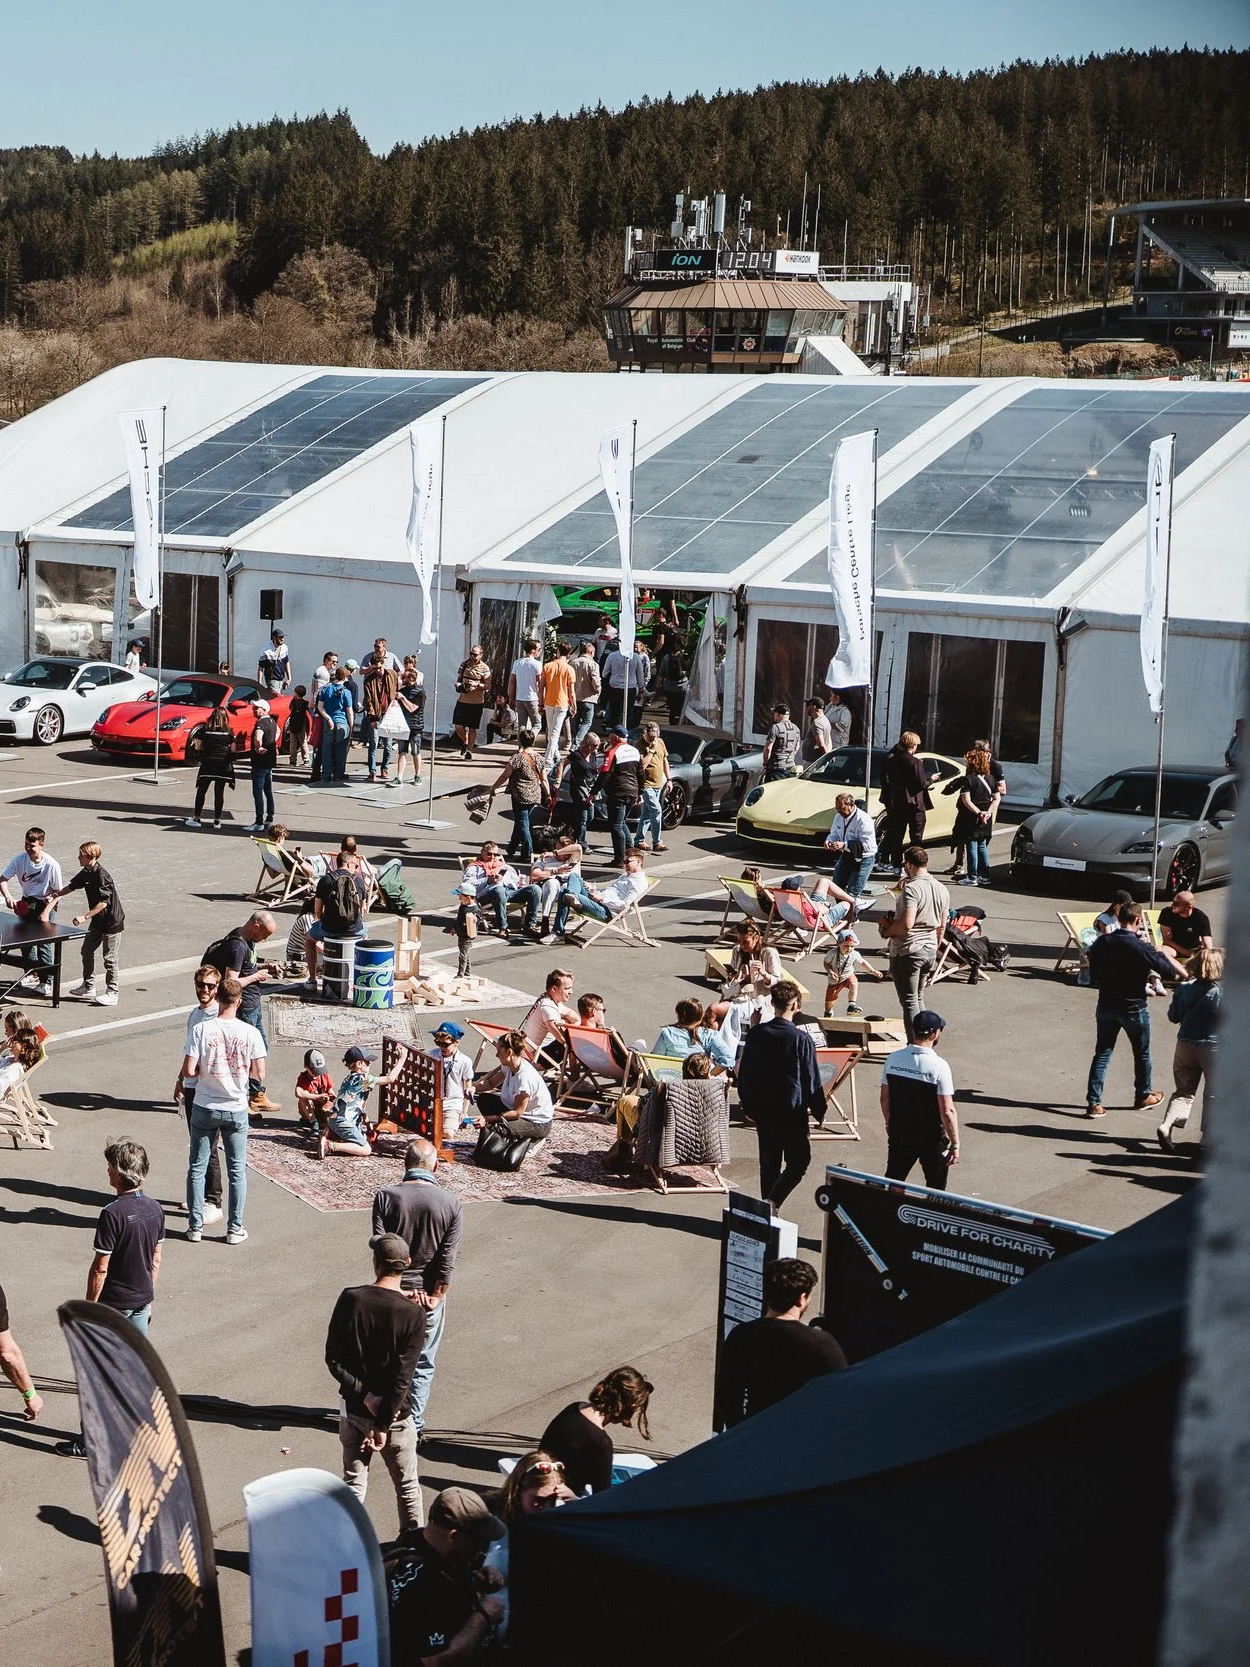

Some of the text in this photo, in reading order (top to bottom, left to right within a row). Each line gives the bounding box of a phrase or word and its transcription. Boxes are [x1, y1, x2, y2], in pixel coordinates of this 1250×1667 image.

[728, 252, 772, 269] 12.04
[647, 337, 658, 345] Royal
[915, 1218, 1056, 1260] DRIVE FOR CHARITY
[912, 1251, 933, 1265] SPORT
[934, 1256, 974, 1275] AUTOMOBILE
[975, 1267, 1001, 1282] CONTRE
[1001, 1273, 1010, 1284] LE
[923, 1242, 958, 1259] MOBILISER
[958, 1251, 967, 1261] LA
[1014, 1264, 1025, 1276] DU
[116, 1542, 143, 1590] CAR
[138, 1449, 183, 1546] PROTECT
